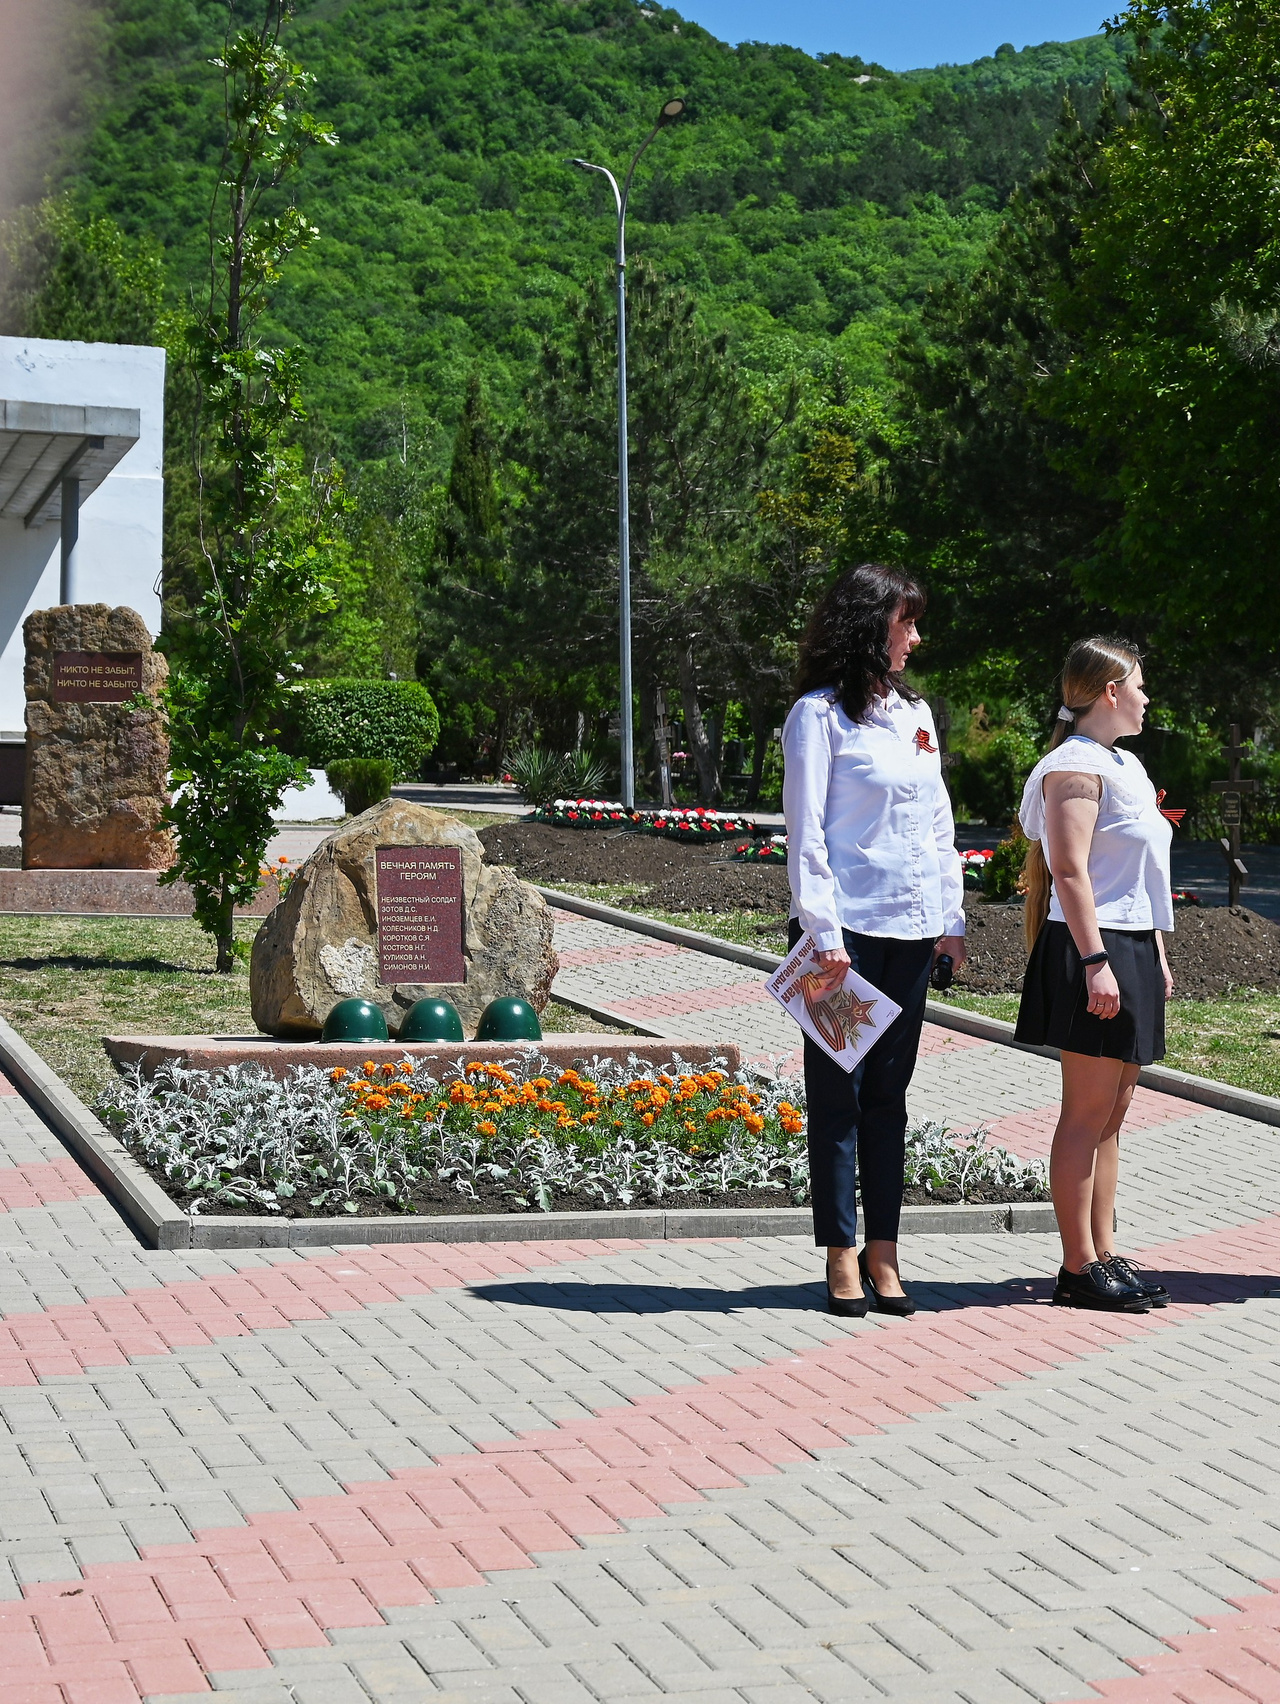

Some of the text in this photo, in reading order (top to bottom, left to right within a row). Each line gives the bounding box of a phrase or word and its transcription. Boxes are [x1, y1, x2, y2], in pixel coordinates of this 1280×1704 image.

[60, 666, 89, 674] НИКТО
[90, 666, 103, 674] НЕ
[88, 680, 101, 688] НЕ
[102, 680, 139, 688] ЗАБЫТО
[380, 862, 456, 870] ВЕЧНАЯ ПАМЯТЬ
[400, 872, 437, 880] ГЕРОЯМ
[381, 896, 457, 904] НЕИЗВЕСТНЫЙ СОЛДАТ
[381, 915, 423, 923] ИНОЗЕМЦЕВ
[383, 963, 418, 971] СИМОНОВ
[771, 935, 817, 993] День Победы!
